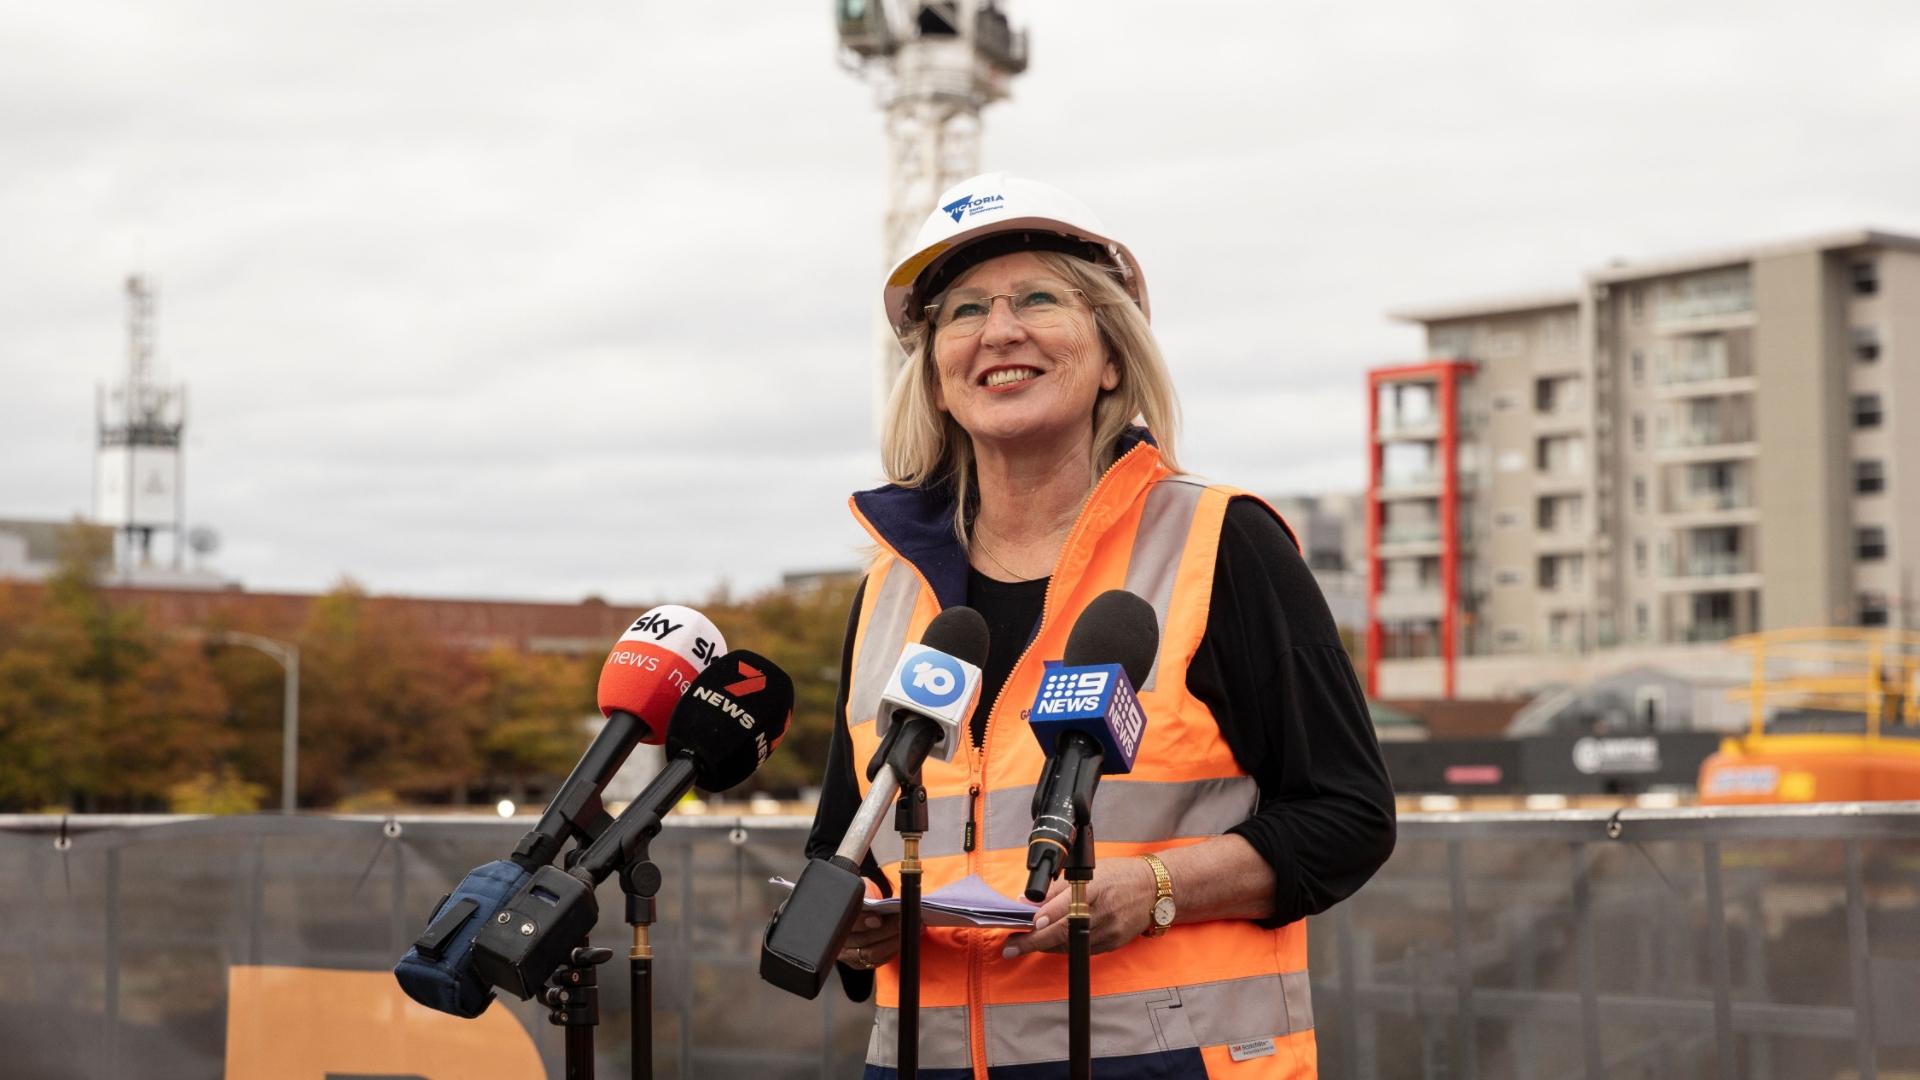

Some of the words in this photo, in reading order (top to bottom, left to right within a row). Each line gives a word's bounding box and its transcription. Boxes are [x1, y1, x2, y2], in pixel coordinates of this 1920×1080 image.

[947, 194, 1004, 215] VICTORIA
[631, 613, 684, 640] sky
[608, 650, 660, 672] news
[691, 636, 720, 666] sk
[668, 668, 691, 697] ne
[912, 661, 956, 695] 10
[1074, 671, 1109, 696] 9
[693, 686, 756, 729] NEWS
[1037, 696, 1100, 714] NEWS
[1108, 704, 1134, 758] NEWS
